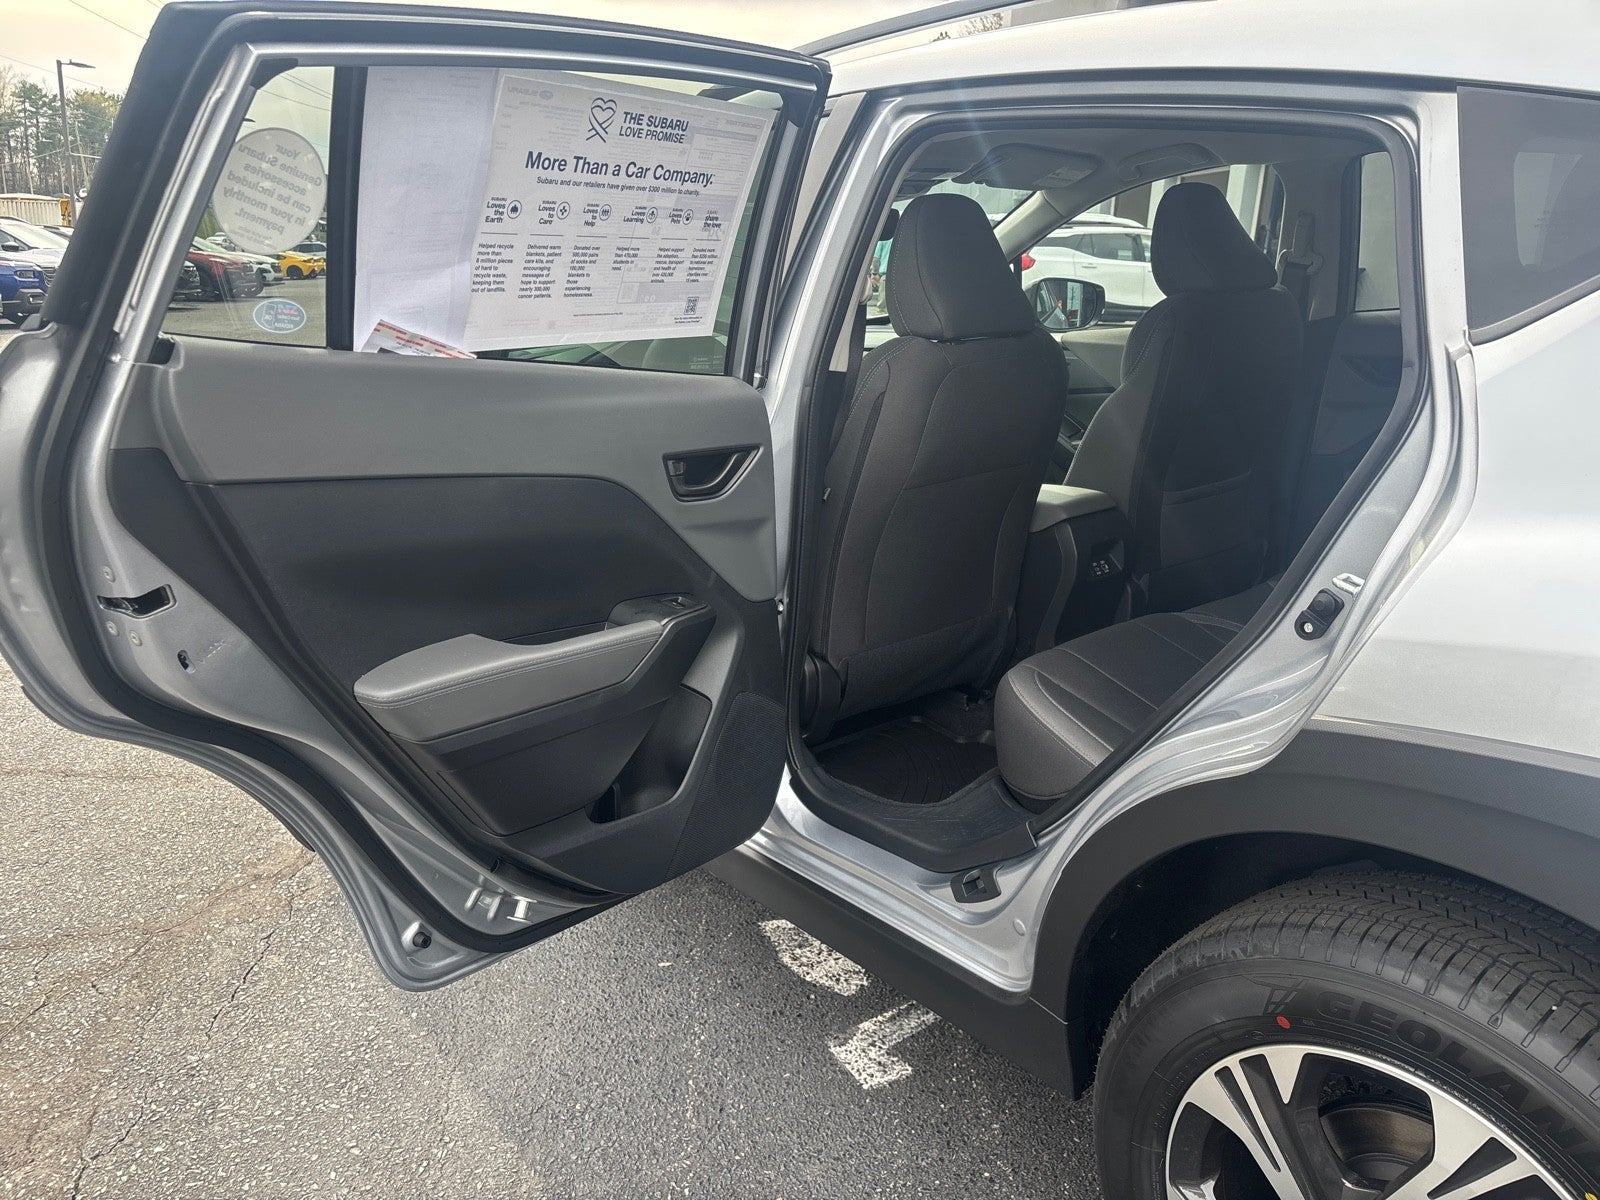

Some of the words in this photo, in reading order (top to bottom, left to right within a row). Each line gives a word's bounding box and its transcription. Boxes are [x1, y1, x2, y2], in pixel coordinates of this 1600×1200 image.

[624, 112, 644, 125] THE
[646, 115, 689, 132] SUBARU
[619, 126, 642, 138] LOVE
[525, 151, 567, 172] More
[574, 156, 608, 175] Than
[612, 164, 621, 176] a
[626, 162, 650, 179] Car
[653, 164, 714, 187] Company.
[537, 176, 558, 185] Subaru
[560, 178, 570, 186] and
[584, 180, 606, 189] retailers
[607, 182, 620, 190] have
[621, 184, 634, 192] given
[648, 184, 660, 192] $300
[487, 201, 505, 209] Loves
[624, 216, 644, 224] Learning
